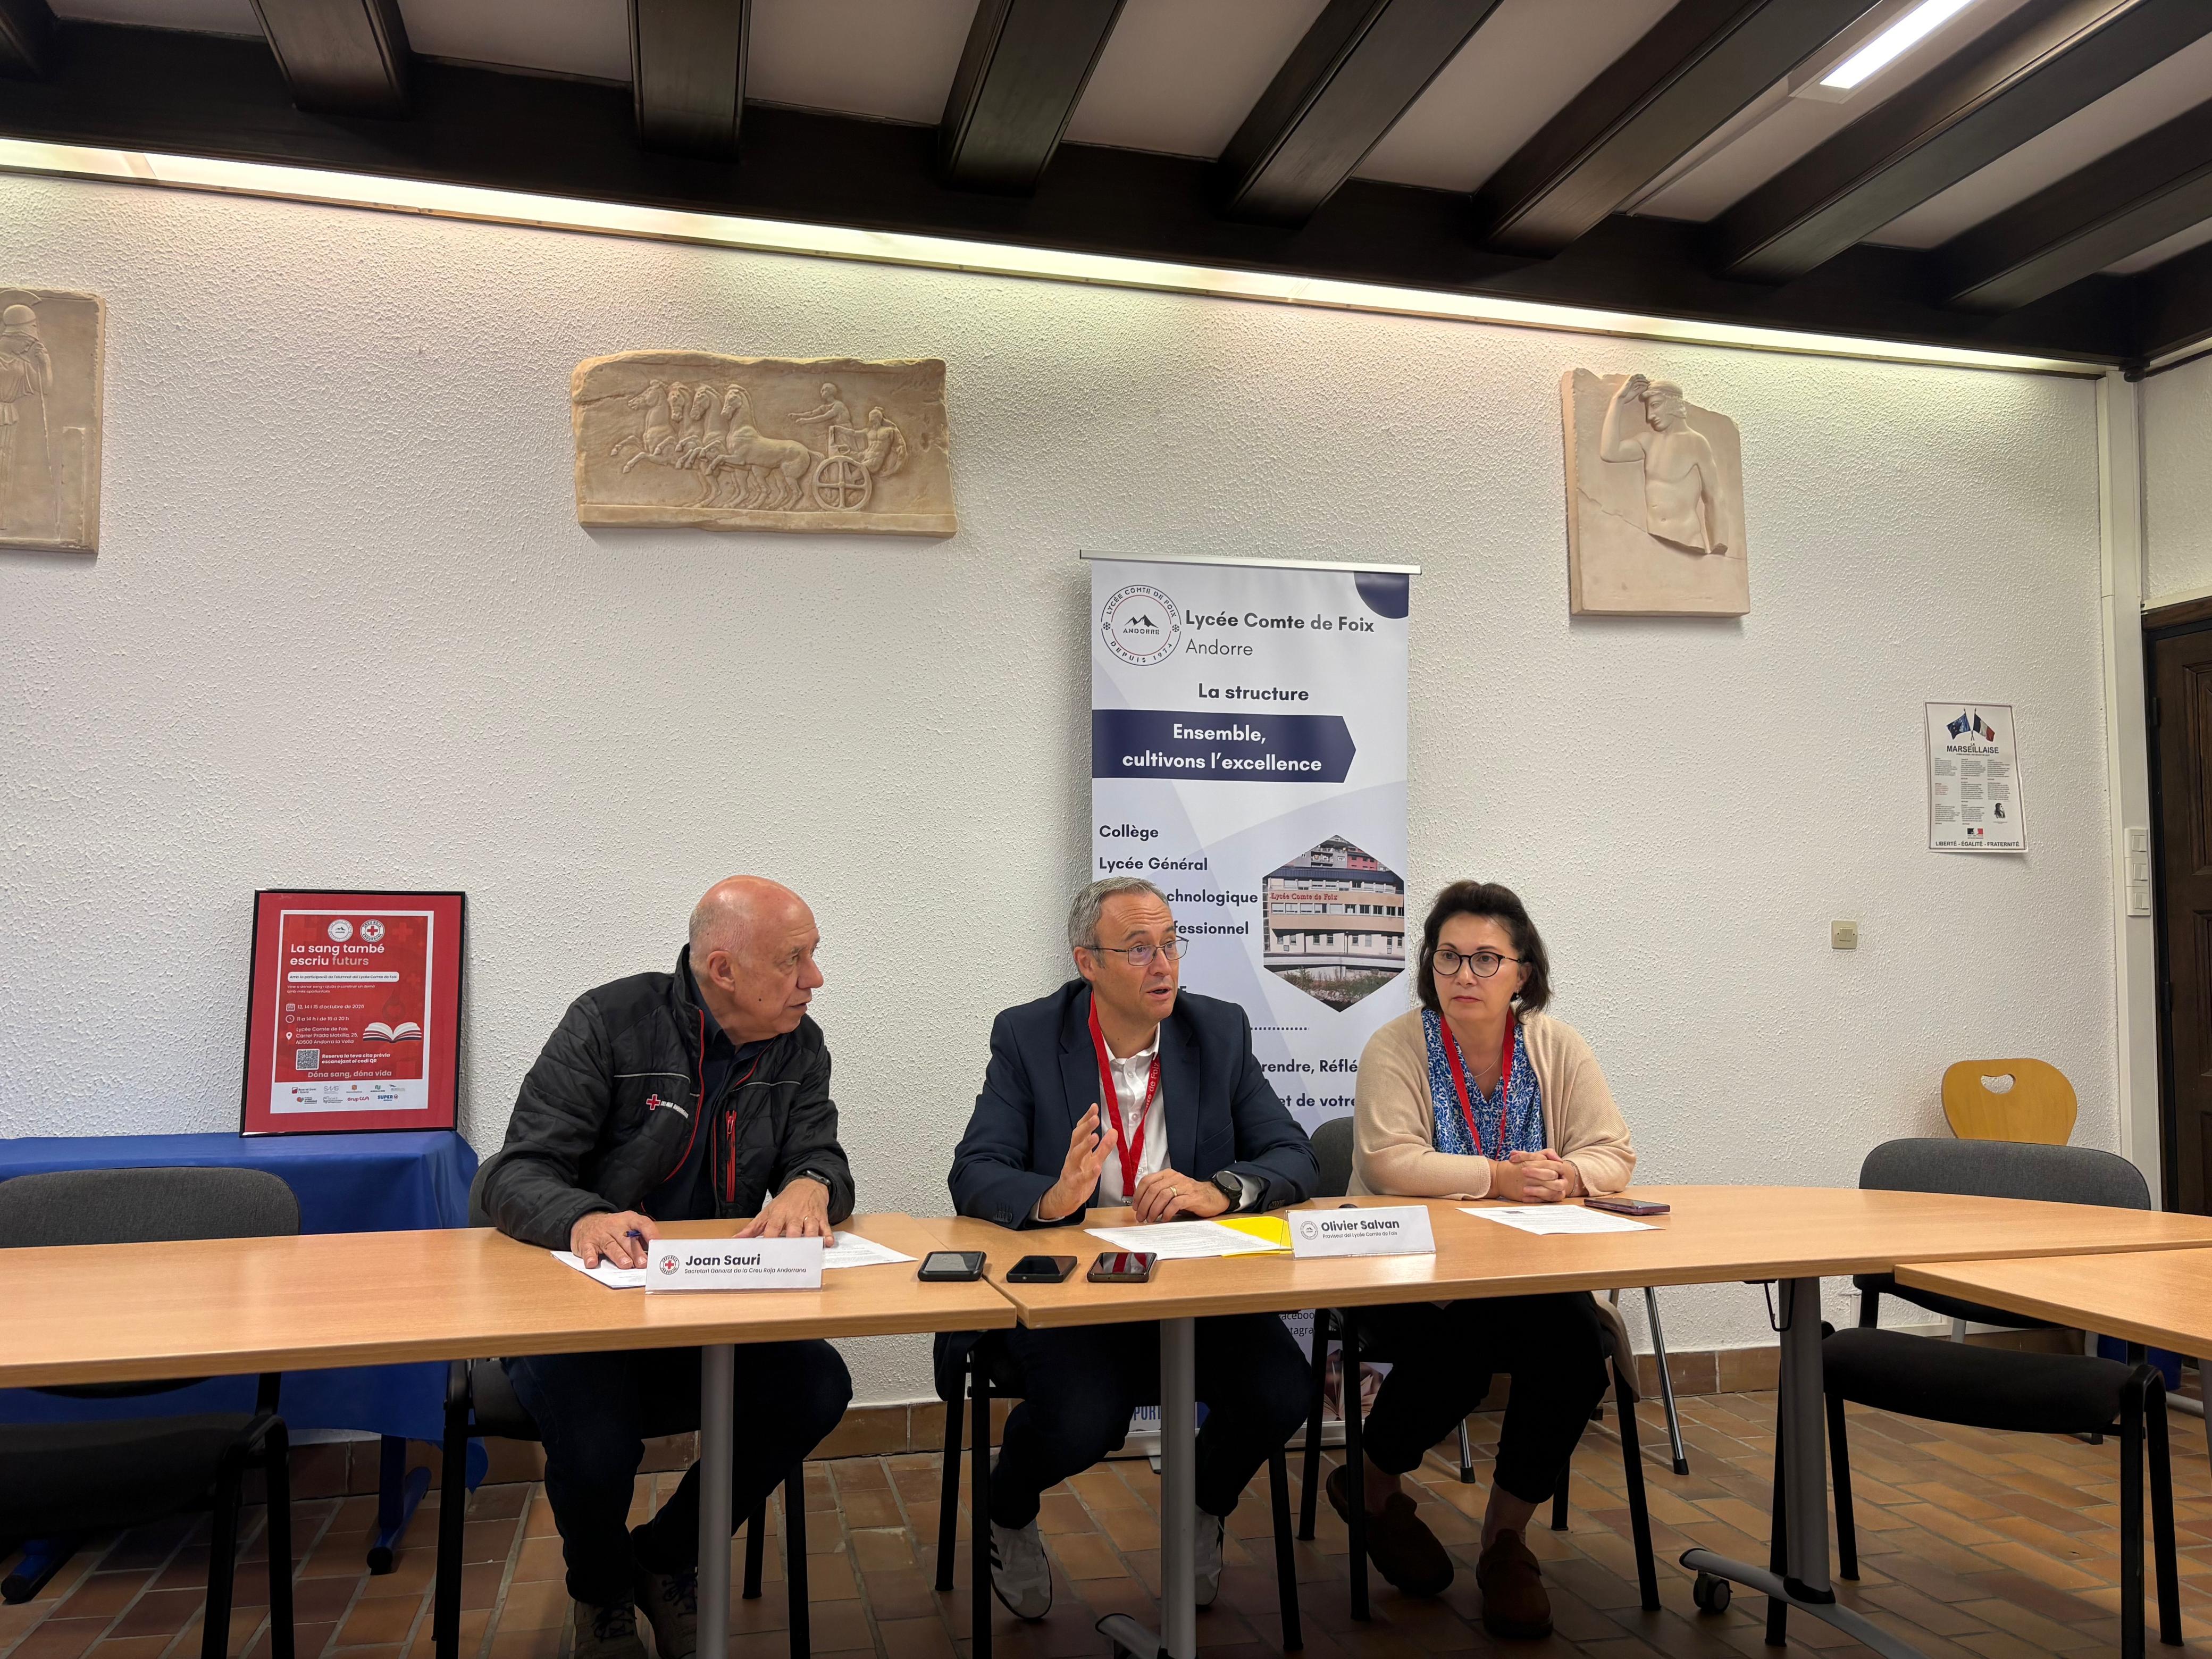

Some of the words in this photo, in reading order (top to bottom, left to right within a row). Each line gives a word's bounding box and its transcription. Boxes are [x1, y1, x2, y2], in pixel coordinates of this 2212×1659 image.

[1106, 593, 1123, 615] LYCÉE
[1125, 587, 1151, 596] COMTE
[1153, 591, 1163, 600] DE
[1164, 599, 1177, 618] FOIX
[1186, 609, 1238, 630] Lycée
[1244, 612, 1305, 629] Comte
[1310, 614, 1333, 630] de
[1338, 616, 1375, 633] Foix
[1110, 641, 1146, 663] DEPUIS
[1185, 638, 1253, 656] Andorre
[1199, 683, 1219, 699] La
[1225, 685, 1309, 701] structure
[1173, 723, 1266, 744] Ensemble,
[1947, 745, 1999, 754] MARSEILLAISE
[1122, 749, 1206, 769] cultivons
[1211, 752, 1322, 771] l'excellence
[1099, 824, 1159, 842] Collège
[1099, 856, 1144, 873] Lycée
[1148, 857, 1208, 870] Général
[1167, 888, 1258, 907] chnologique
[1174, 920, 1249, 935] fessionnel
[290, 944, 305, 953] La
[308, 945, 340, 956] sang
[343, 943, 385, 953] també
[290, 955, 329, 966] escriu
[332, 956, 369, 966] futurs
[1262, 1059, 1315, 1075] rendre,
[1319, 1058, 1358, 1073] Réflé
[1296, 1093, 1316, 1107] de
[1321, 1220, 1358, 1231] Olivier
[1360, 1219, 1400, 1230] Salvan
[685, 1255, 720, 1266] Joan
[724, 1253, 761, 1266] Sauri
[1290, 1327, 1315, 1337] tagra
